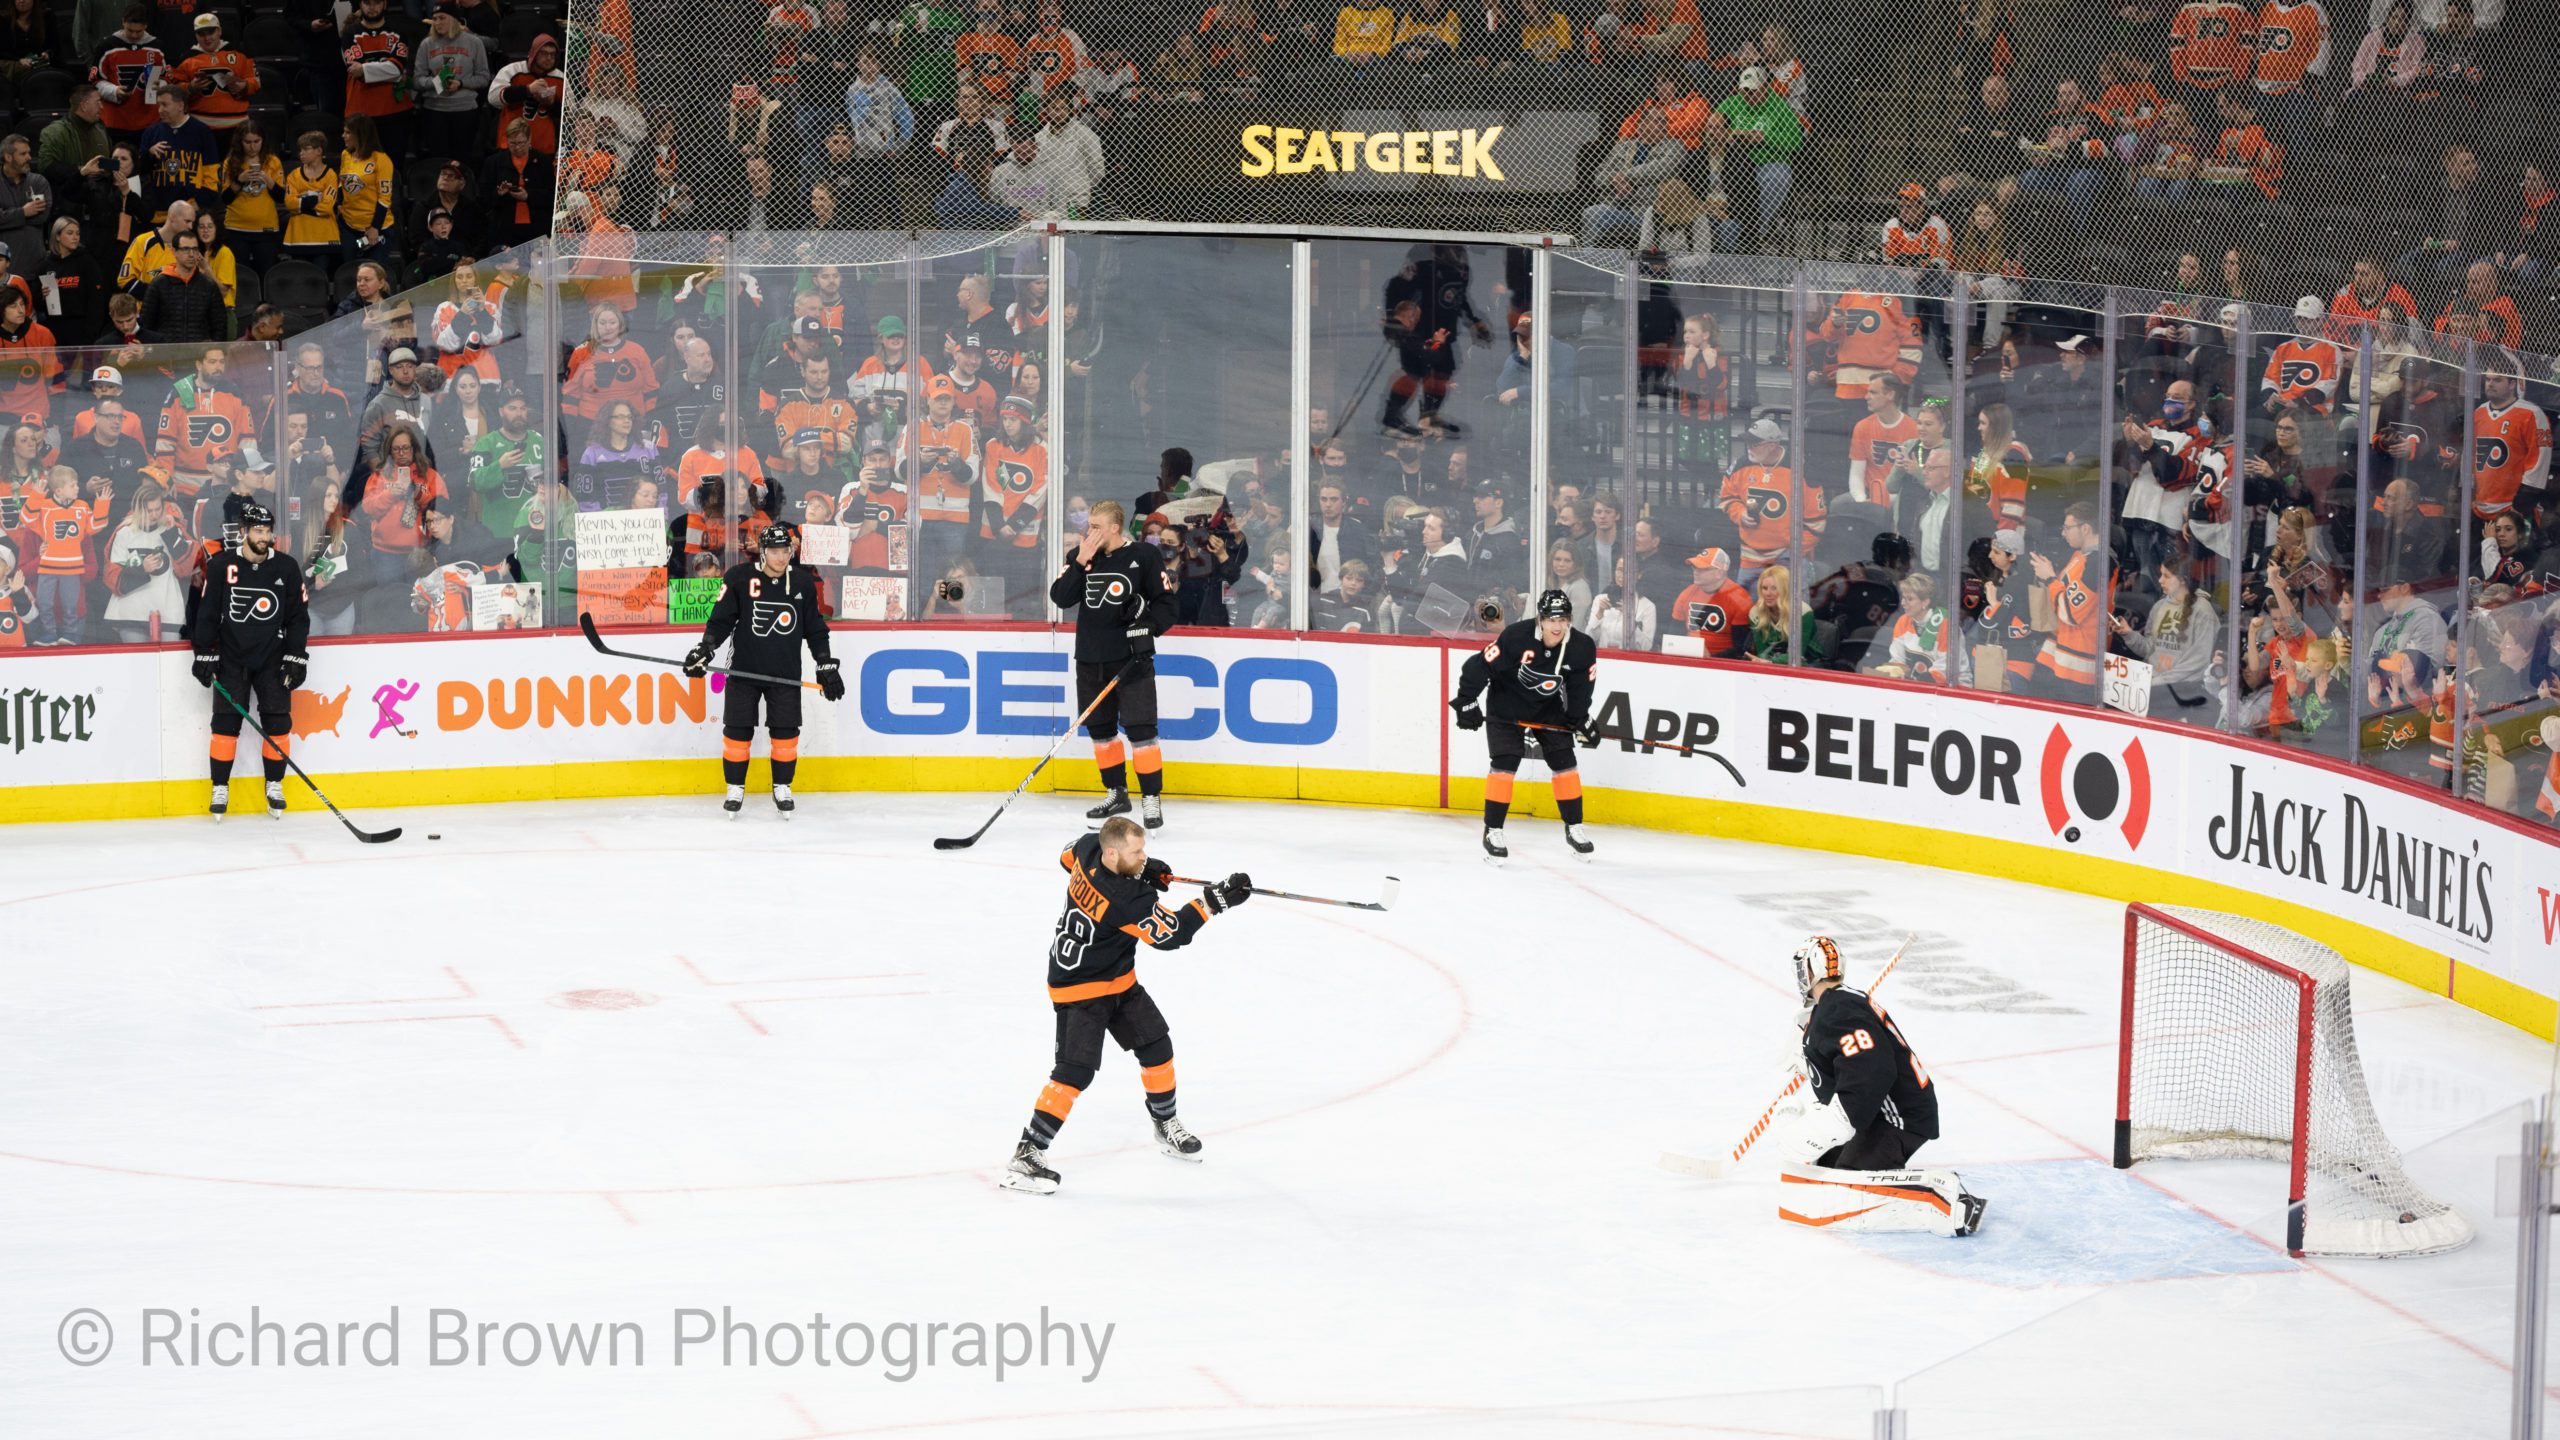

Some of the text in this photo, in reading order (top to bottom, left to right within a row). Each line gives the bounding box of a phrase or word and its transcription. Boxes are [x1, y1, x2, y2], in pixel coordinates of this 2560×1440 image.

[1240, 124, 1506, 182] SEATGEEK
[605, 533, 635, 544] make
[637, 533, 655, 544] my
[227, 564, 239, 584] C
[670, 579, 691, 593] WIN
[749, 577, 761, 597] C
[672, 607, 710, 622] THANK
[843, 599, 869, 613] ME?
[2103, 656, 2129, 679] #45
[2110, 681, 2149, 713] STUD
[1767, 707, 2023, 806] BELFOR
[1138, 904, 1179, 944] 28
[1838, 1027, 1875, 1058] 28
[1866, 1175, 1923, 1183] TRUE
